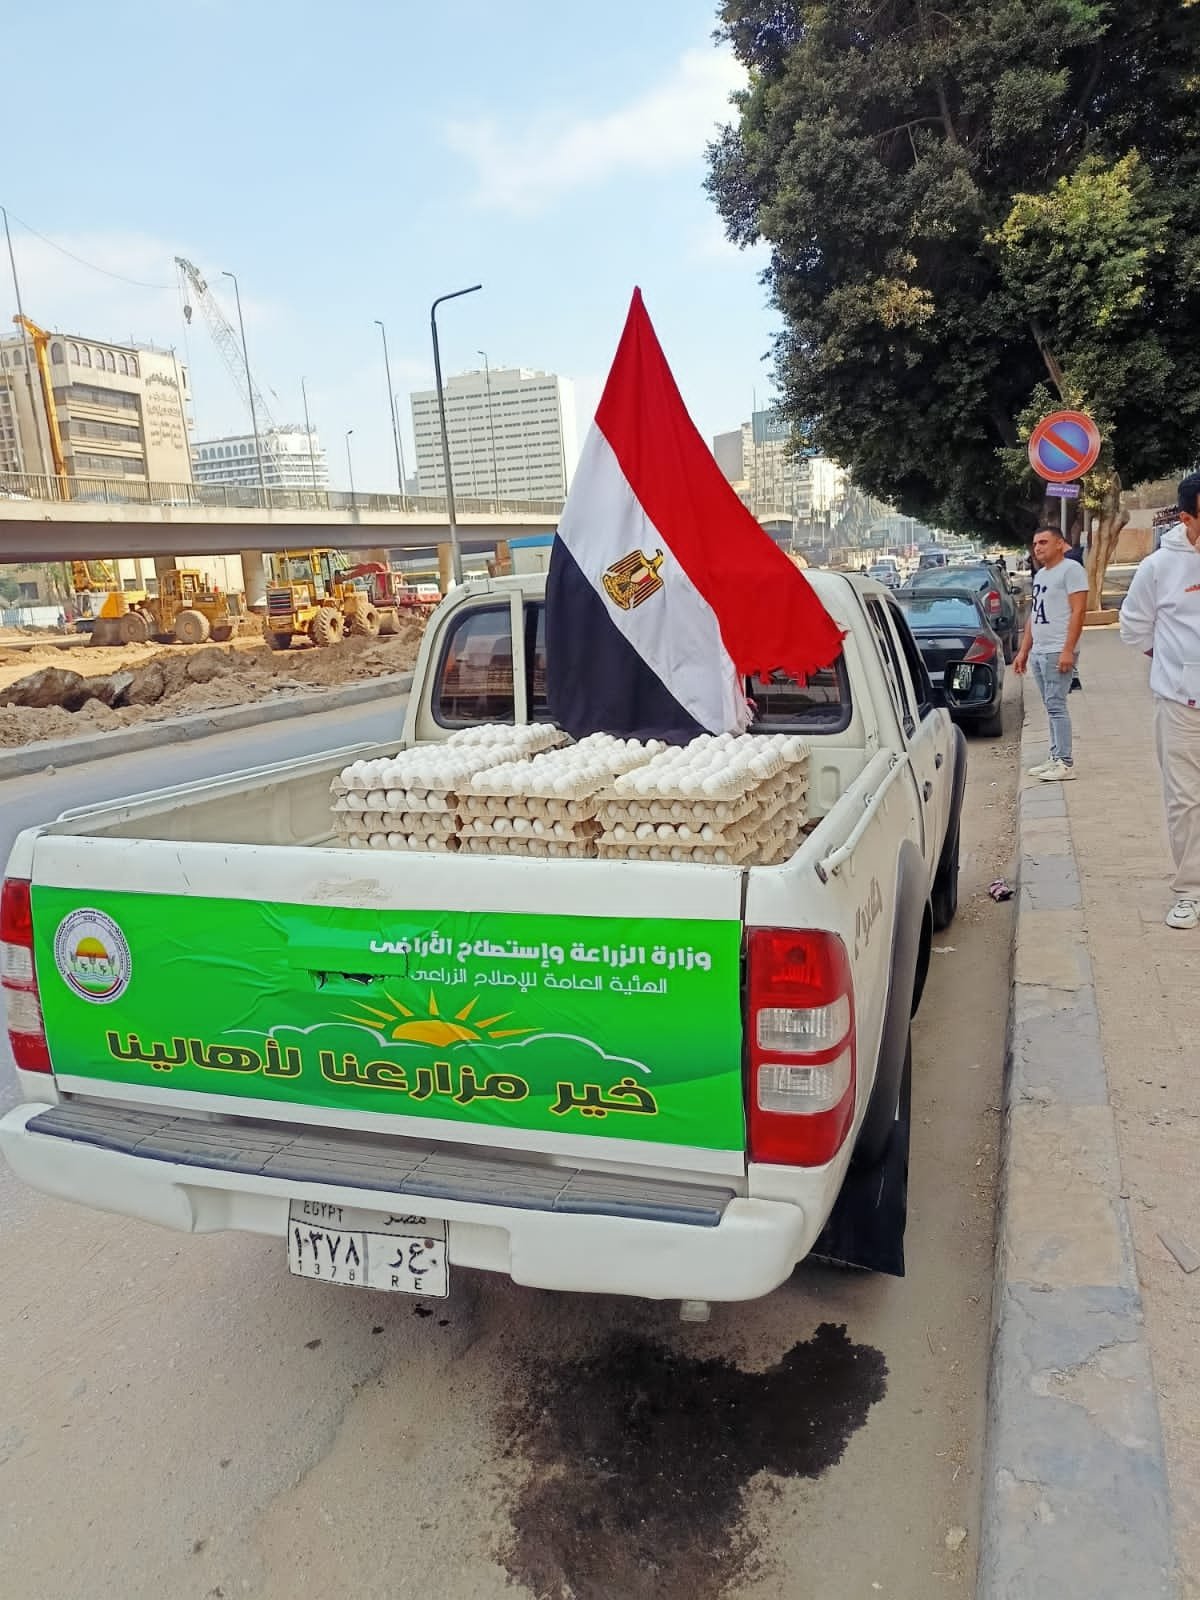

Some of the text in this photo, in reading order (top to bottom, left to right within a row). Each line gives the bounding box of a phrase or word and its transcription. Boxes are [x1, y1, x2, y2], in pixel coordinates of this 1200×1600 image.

[457, 937, 565, 968] وإستصلاح
[570, 942, 646, 967] الزراعة
[651, 945, 712, 971] وزارة
[473, 970, 537, 993] للإصلاح
[543, 973, 602, 991] العامة
[105, 1029, 657, 1117] خير مزارعنا لأهالينا
[304, 1200, 343, 1224] EGYPT
[384, 1214, 426, 1226] مصر
